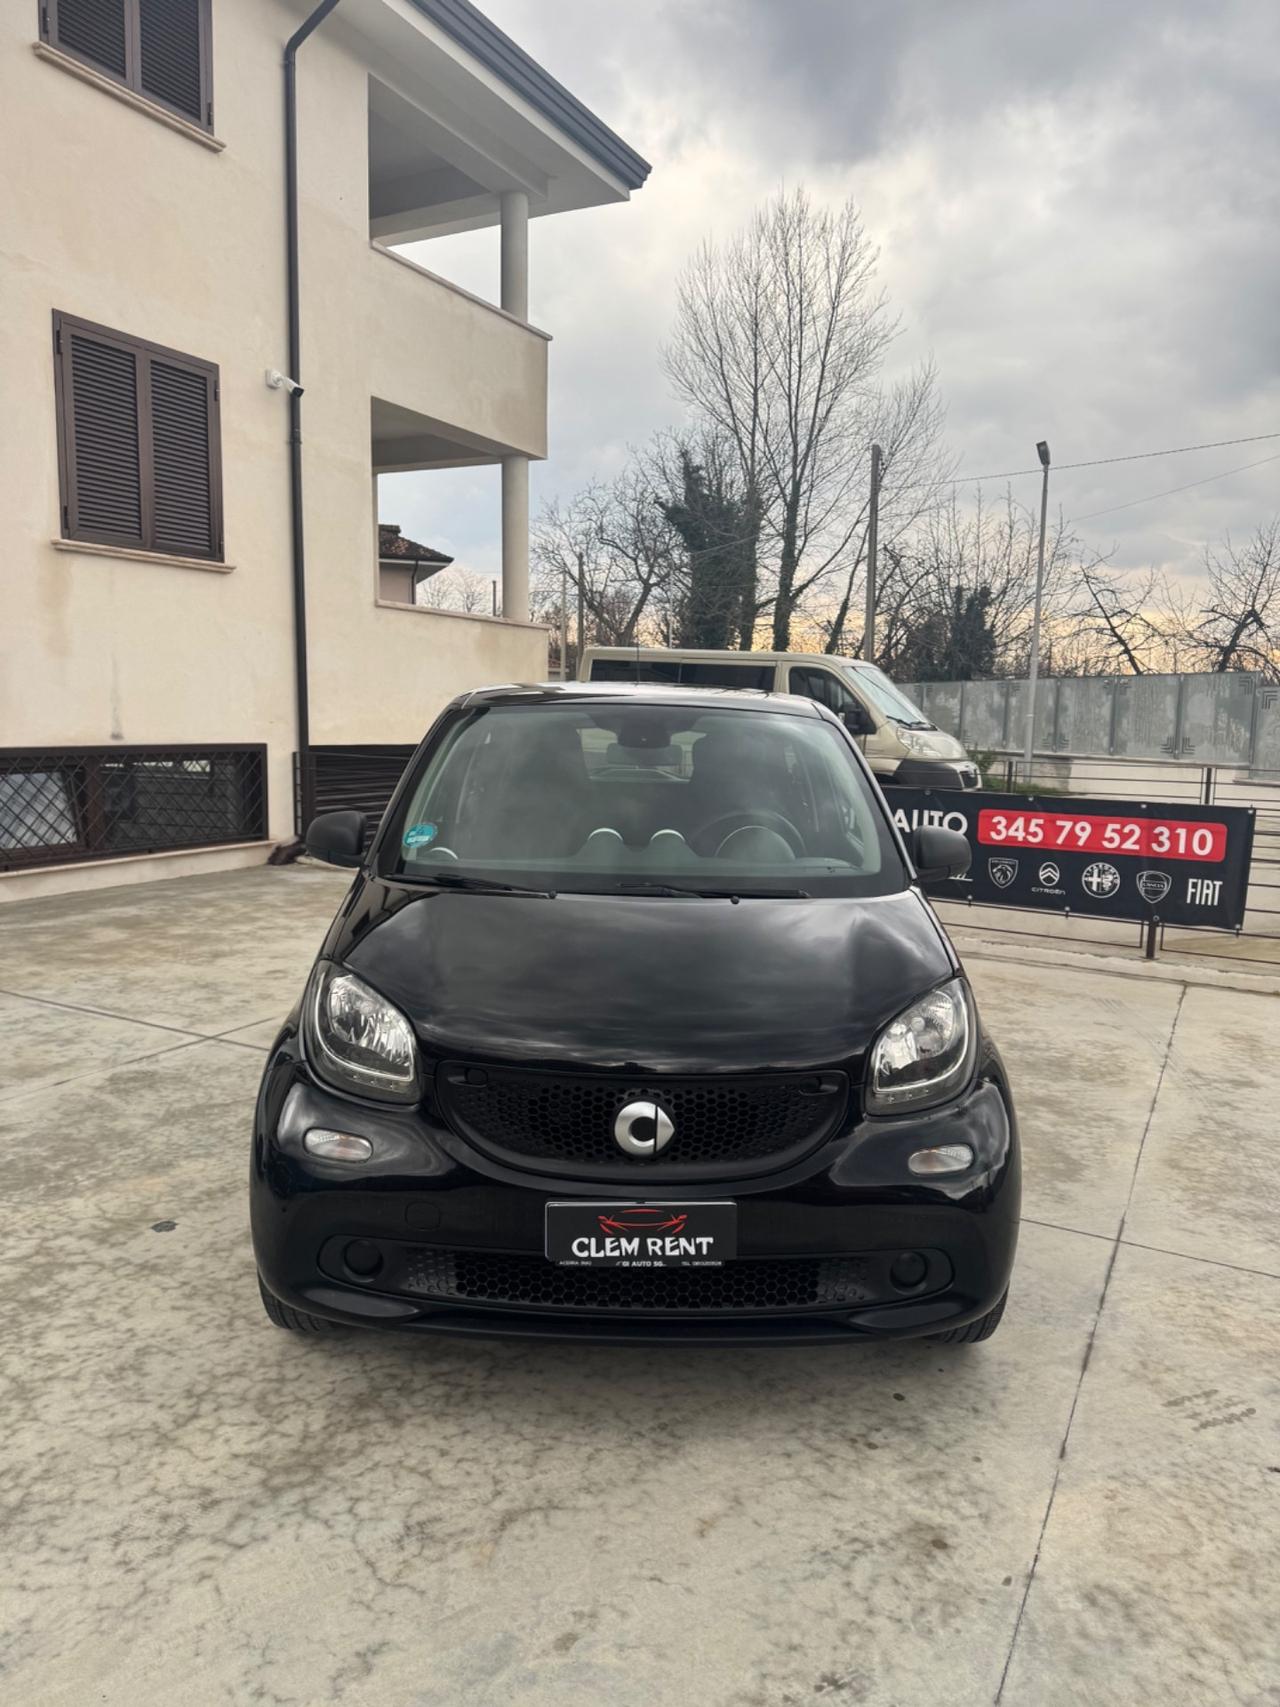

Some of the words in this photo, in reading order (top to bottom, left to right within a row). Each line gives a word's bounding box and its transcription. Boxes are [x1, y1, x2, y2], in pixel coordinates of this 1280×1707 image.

[894, 808, 968, 834] AUTO
[990, 815, 1044, 843] 345
[1055, 820, 1092, 847] 79
[1101, 823, 1141, 850] 52
[1151, 826, 1214, 856] 310
[1186, 878, 1224, 906] FIAT
[571, 1237, 640, 1257] CLEM
[646, 1237, 714, 1256] RENT
[631, 1260, 652, 1268] AUTO
